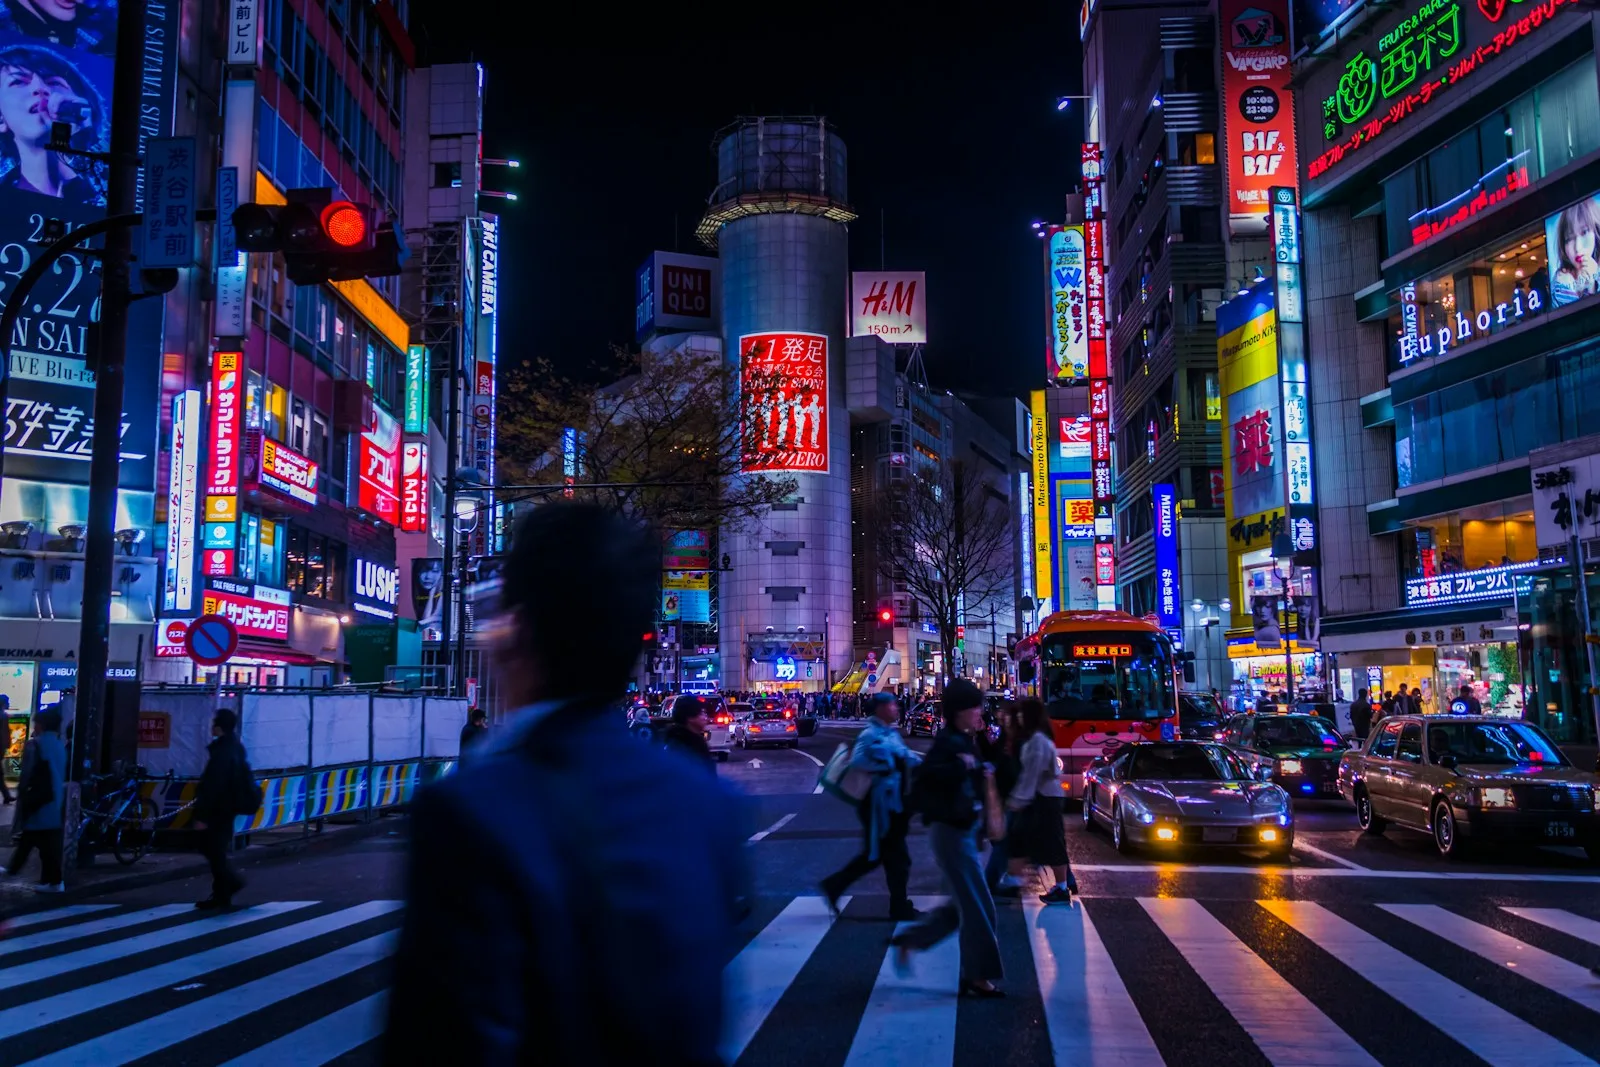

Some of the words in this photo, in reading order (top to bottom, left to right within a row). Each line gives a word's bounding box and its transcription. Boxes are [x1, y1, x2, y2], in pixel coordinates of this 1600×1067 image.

[234, 0, 252, 54] 前ビル
[1226, 52, 1288, 72] VANGUARD
[1381, 3, 1460, 98] 西村
[1245, 96, 1274, 105] 10:00
[1245, 105, 1274, 114] 23:00
[1323, 96, 1336, 140] 渋谷
[1242, 131, 1280, 152] B1F
[1277, 142, 1286, 153] &
[1243, 154, 1283, 177] B2F
[151, 164, 163, 214] Shibuya
[165, 147, 188, 256] 渋谷駅前
[481, 250, 495, 315] CAMERA
[667, 271, 702, 293] UNI
[667, 292, 706, 313] QLO
[862, 280, 917, 317] H&M
[1397, 288, 1542, 363] Euphoria
[779, 338, 824, 362] 発足
[1287, 399, 1297, 428] パーラー
[1295, 395, 1305, 425] フルーツ
[215, 392, 237, 486] サンドラッグ
[1036, 416, 1044, 452] KiYoshi
[1235, 409, 1274, 479] 薬
[274, 457, 308, 486] サンドラッグ
[368, 446, 393, 489] アコム
[1037, 451, 1046, 507] Matsumoto
[1290, 460, 1299, 490] フルーツ
[1299, 456, 1308, 487] 渋谷西村
[404, 478, 418, 513] アコム
[405, 516, 416, 524] 3F
[1160, 494, 1172, 538] MIZUHO
[1295, 517, 1315, 552] HUB
[212, 579, 223, 589] TAX
[223, 581, 236, 591] FREE
[235, 584, 249, 594] SHOP
[355, 558, 396, 606] LUSH
[1162, 569, 1173, 615] みずほ銀行
[1407, 581, 1452, 599] 渋谷西村
[226, 602, 277, 631] サンドラッグ
[168, 629, 185, 638] ガスト
[1075, 646, 1131, 655] 渋谷駅西口
[114, 668, 137, 677] BLDG
[1546, 827, 1574, 837] 51-58
